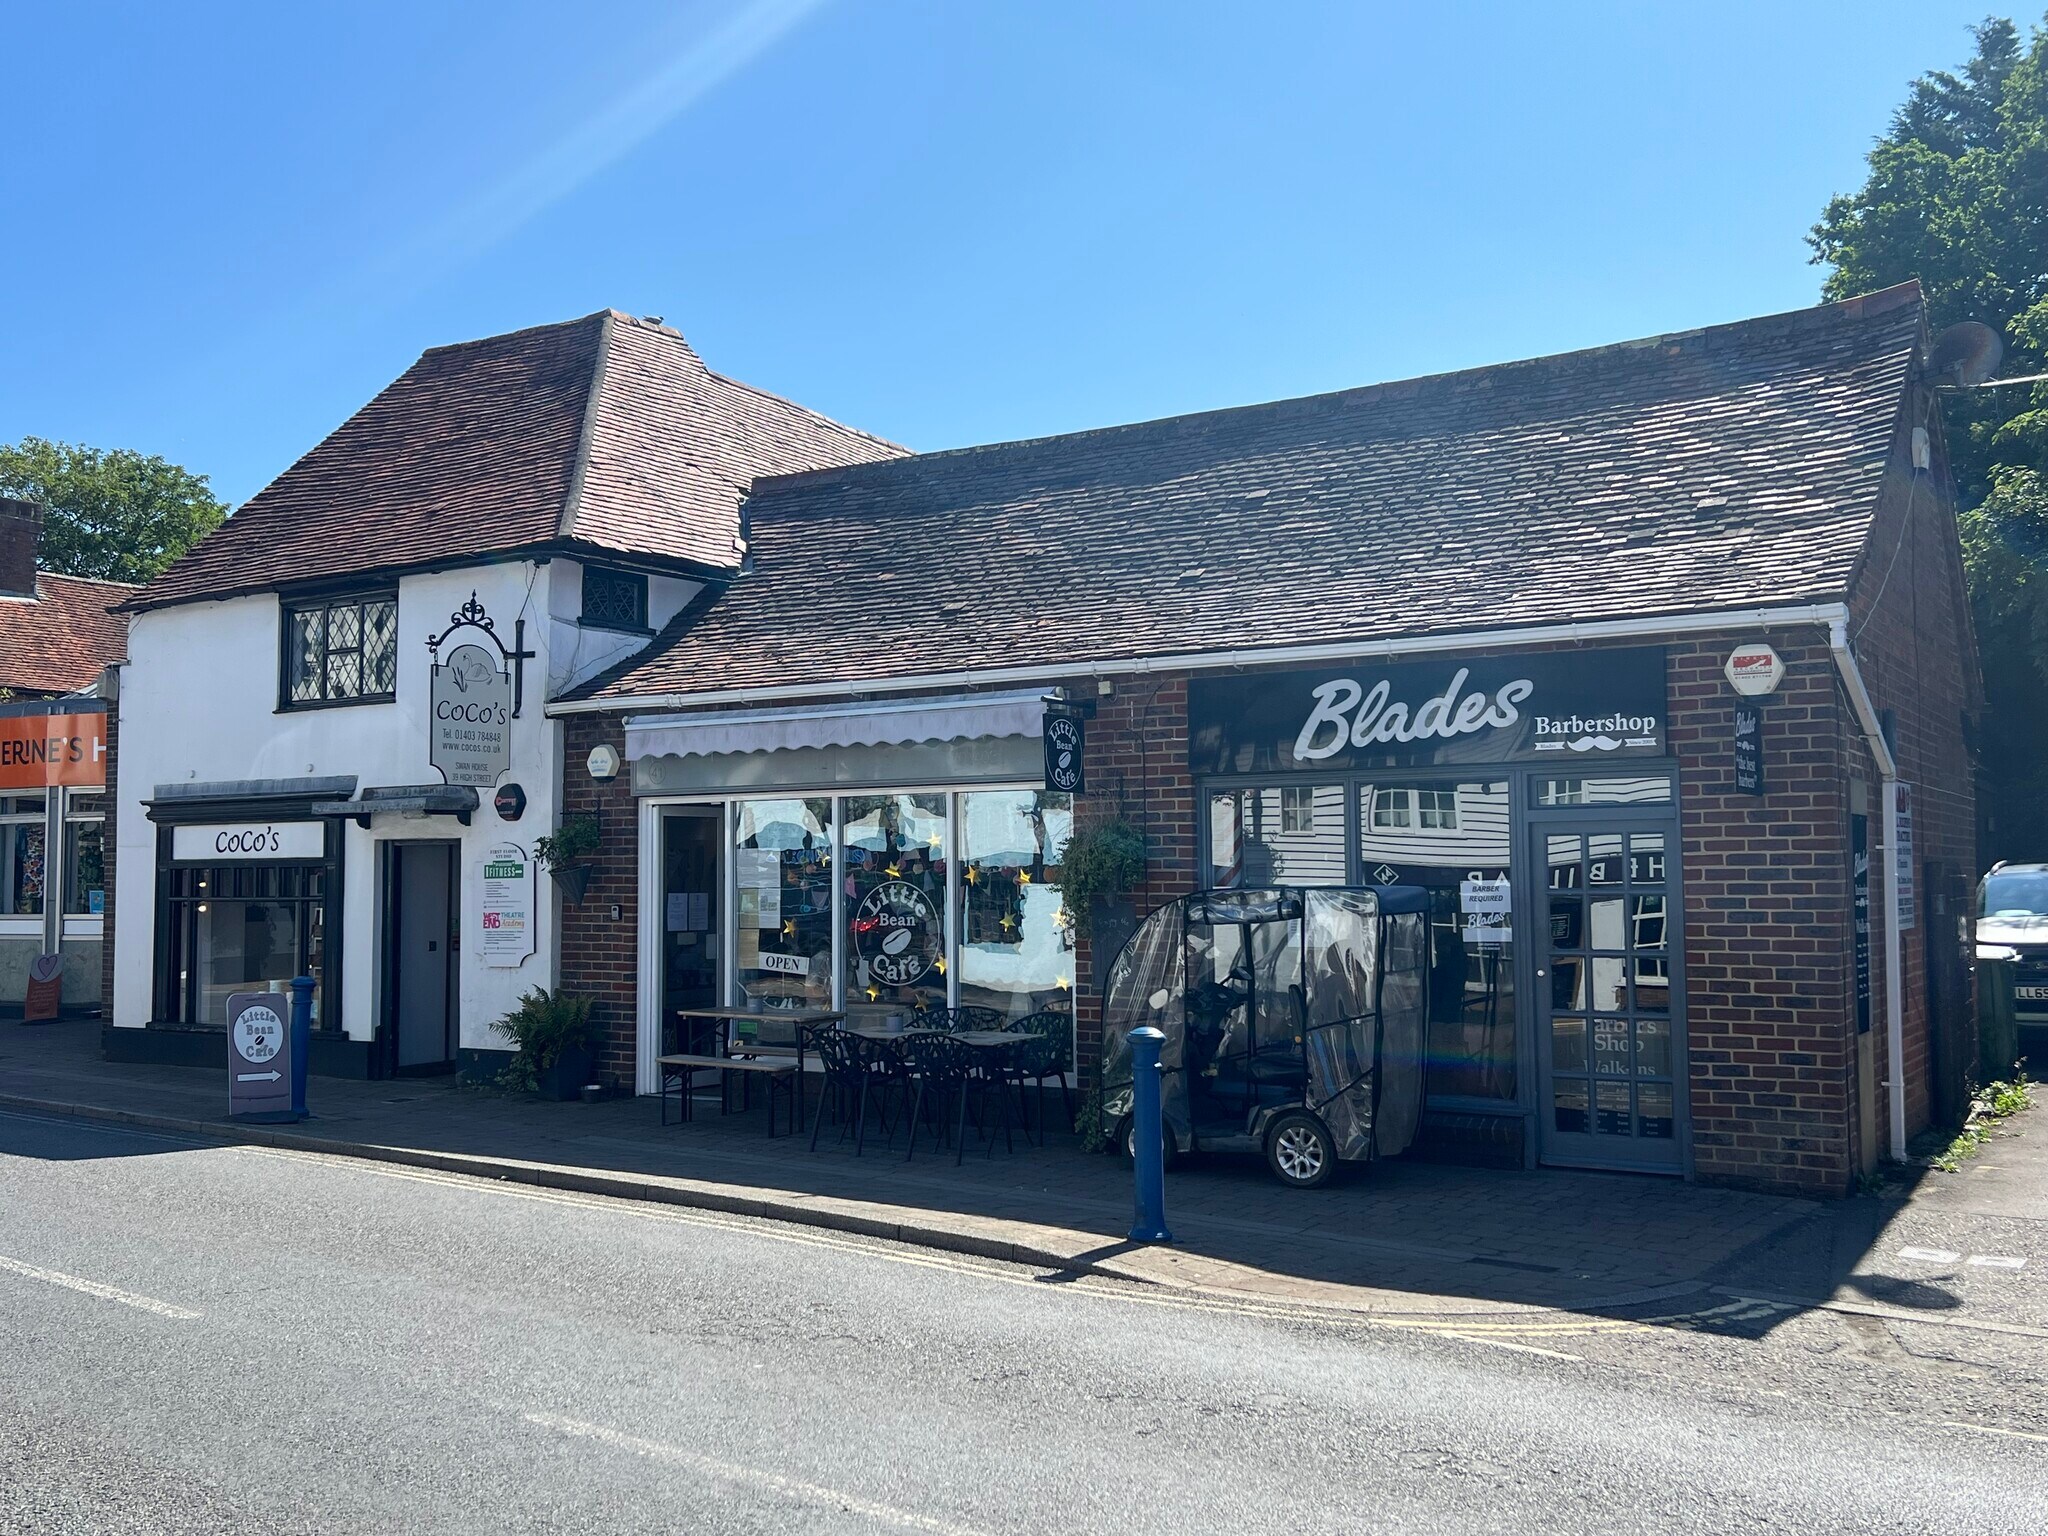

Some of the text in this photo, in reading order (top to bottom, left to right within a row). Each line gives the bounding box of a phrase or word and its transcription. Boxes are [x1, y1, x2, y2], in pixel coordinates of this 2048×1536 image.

[1294, 668, 1533, 760] Blades
[1534, 712, 1656, 736] Barbershop
[455, 729, 476, 741] 01403
[477, 731, 502, 743] 784848
[1050, 721, 1077, 745] Little
[2, 736, 83, 766] ERINE'S
[1056, 740, 1073, 751] Bean
[455, 762, 488, 772] SWAN HOUSE
[460, 773, 472, 781] HIGH
[474, 774, 491, 782] STREET
[1472, 885, 1500, 893] BARBER
[865, 884, 927, 918] Little
[1468, 894, 1504, 903] REQUIRED
[483, 920, 500, 929] END
[879, 913, 916, 926] Bean
[1467, 911, 1506, 929] Blades
[766, 955, 800, 971] OPEN
[241, 1011, 276, 1025] Little
[246, 1025, 274, 1036] Bean
